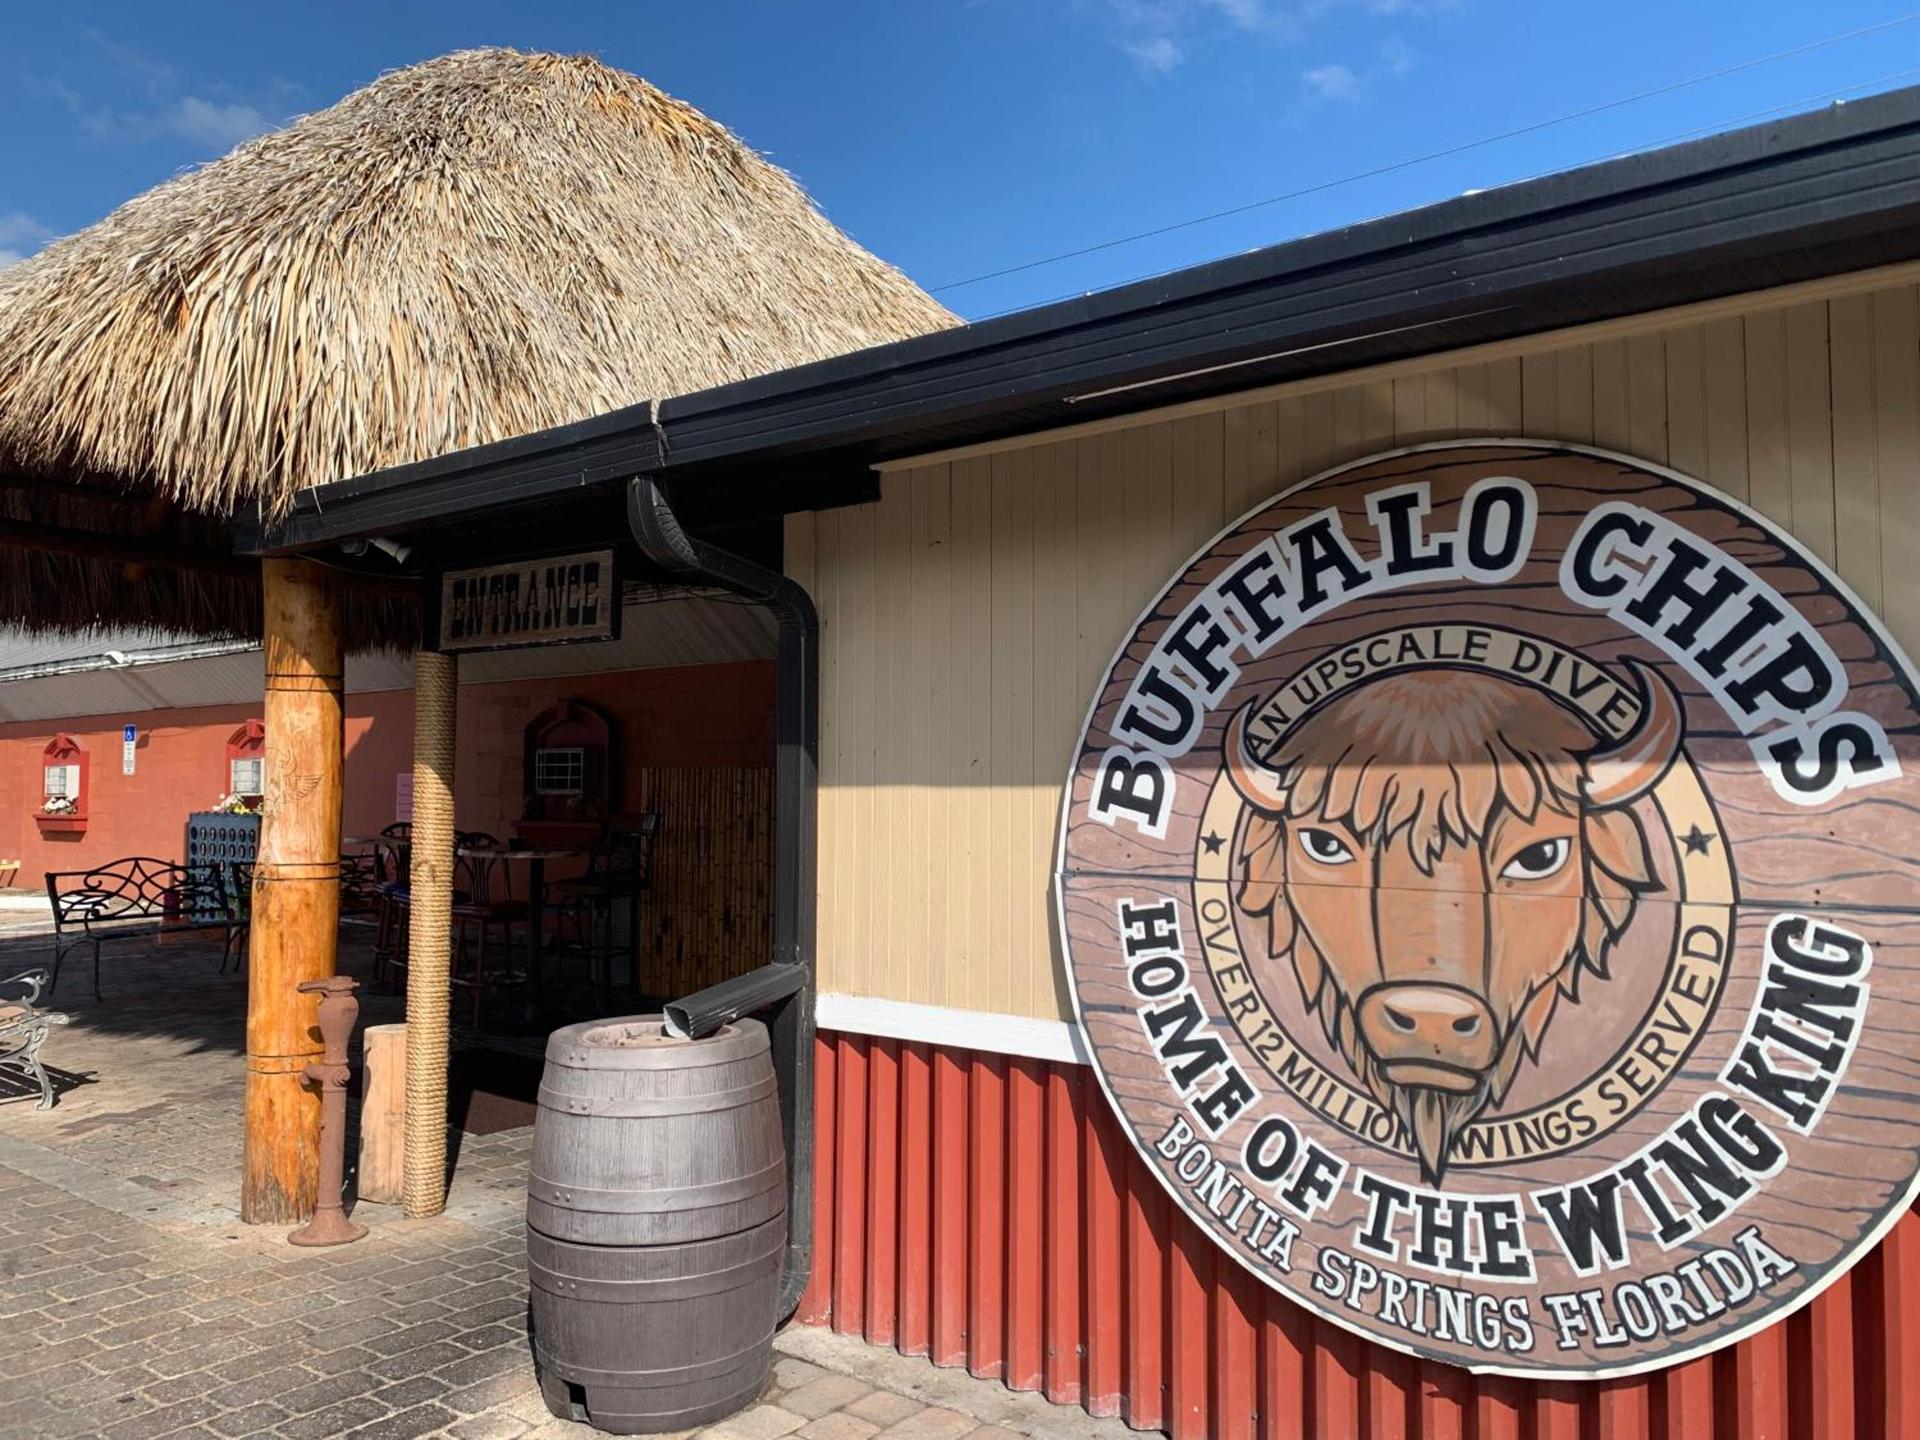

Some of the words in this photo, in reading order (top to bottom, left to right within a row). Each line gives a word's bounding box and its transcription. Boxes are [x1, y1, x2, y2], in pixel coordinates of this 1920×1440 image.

[451, 562, 600, 638] ENTRANCE
[1088, 477, 1538, 838] BUFFALO
[1560, 501, 1902, 806] CHIPS
[1246, 702, 1292, 760] AN
[1289, 628, 1493, 706] UPSCALE
[1509, 640, 1640, 733] DIVE
[1117, 898, 1261, 1139] HOME
[1240, 1112, 1348, 1220] OF
[1353, 1168, 1536, 1283] THE
[1530, 1091, 1787, 1278] WING
[1717, 913, 1872, 1135] KING
[1200, 897, 1259, 1022] OVER
[1247, 1021, 1285, 1064] 12
[1276, 1053, 1418, 1155] MILLION
[1456, 1098, 1597, 1161] WINGS
[1607, 922, 1725, 1116] SERVED
[1154, 1114, 1301, 1274] BONITA
[1312, 1247, 1536, 1353] SPRINGS
[1544, 1225, 1797, 1352] FLORIDA
